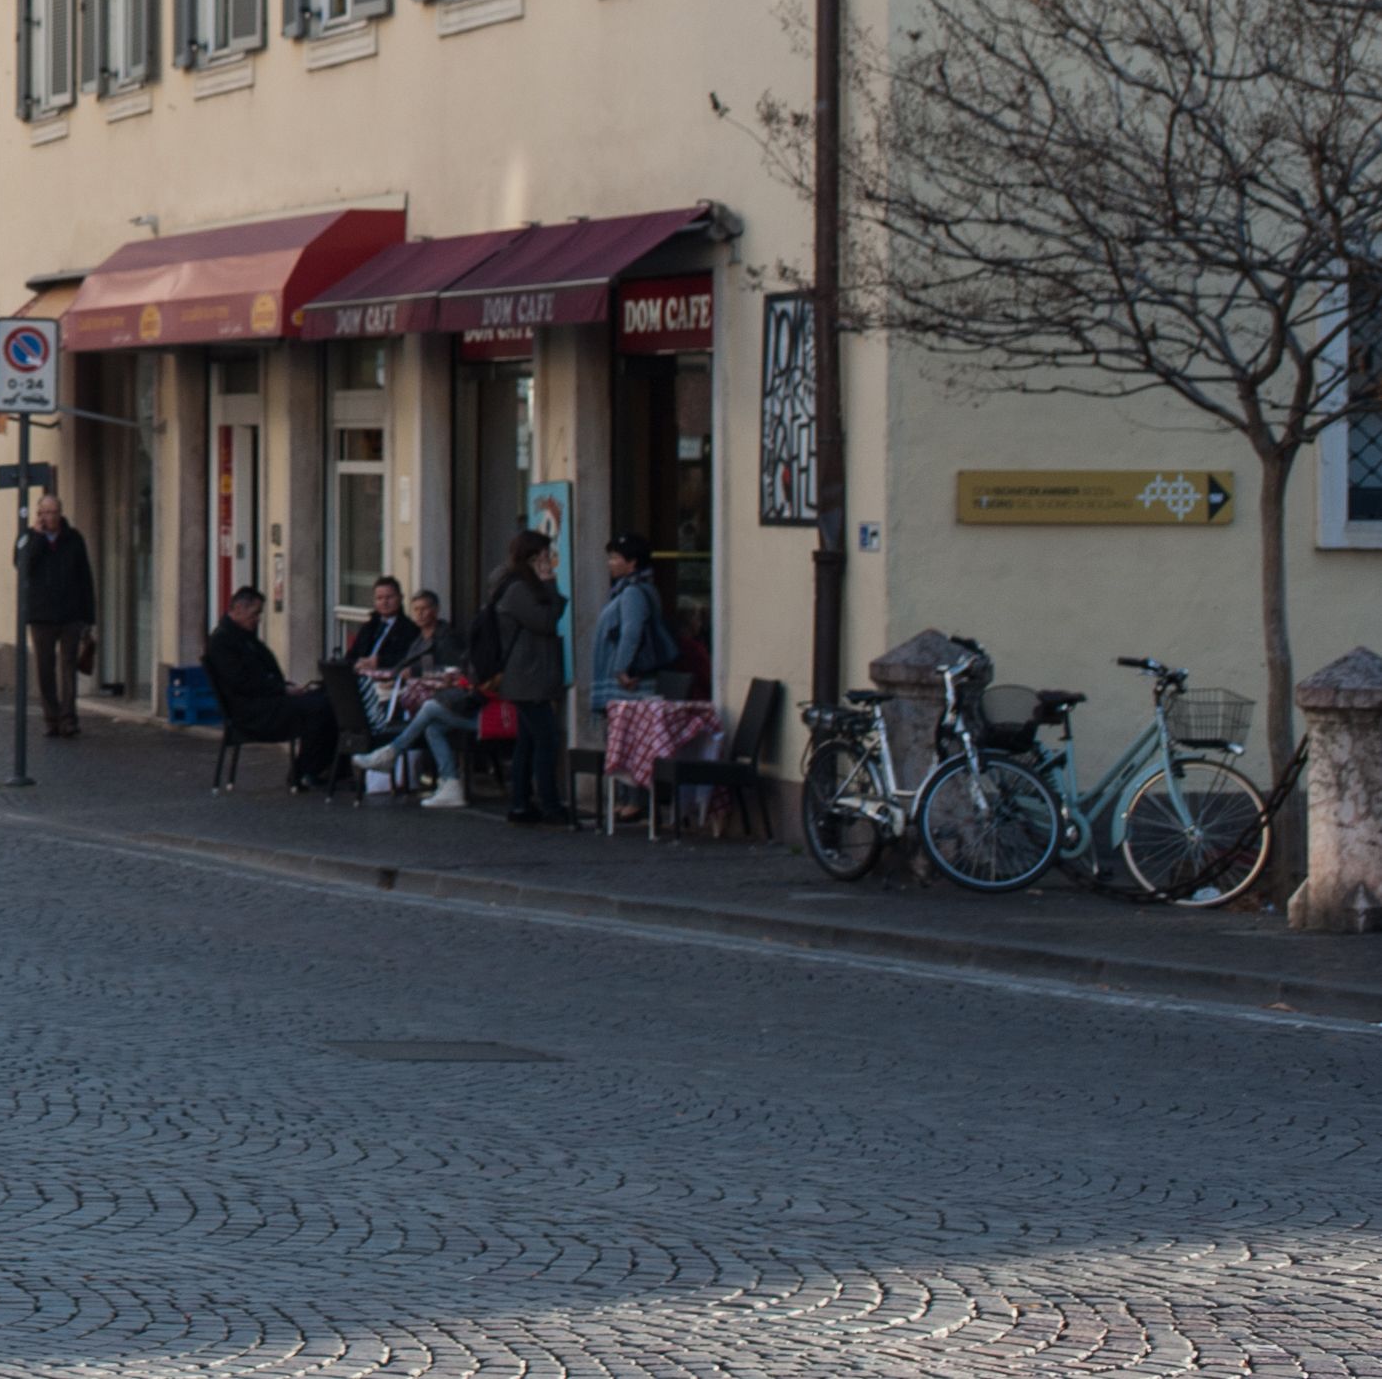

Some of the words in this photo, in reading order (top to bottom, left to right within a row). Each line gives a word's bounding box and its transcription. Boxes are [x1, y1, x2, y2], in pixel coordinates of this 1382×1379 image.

[480, 295, 514, 327] DOM
[622, 297, 663, 335] DOM
[665, 293, 712, 331] CAFE
